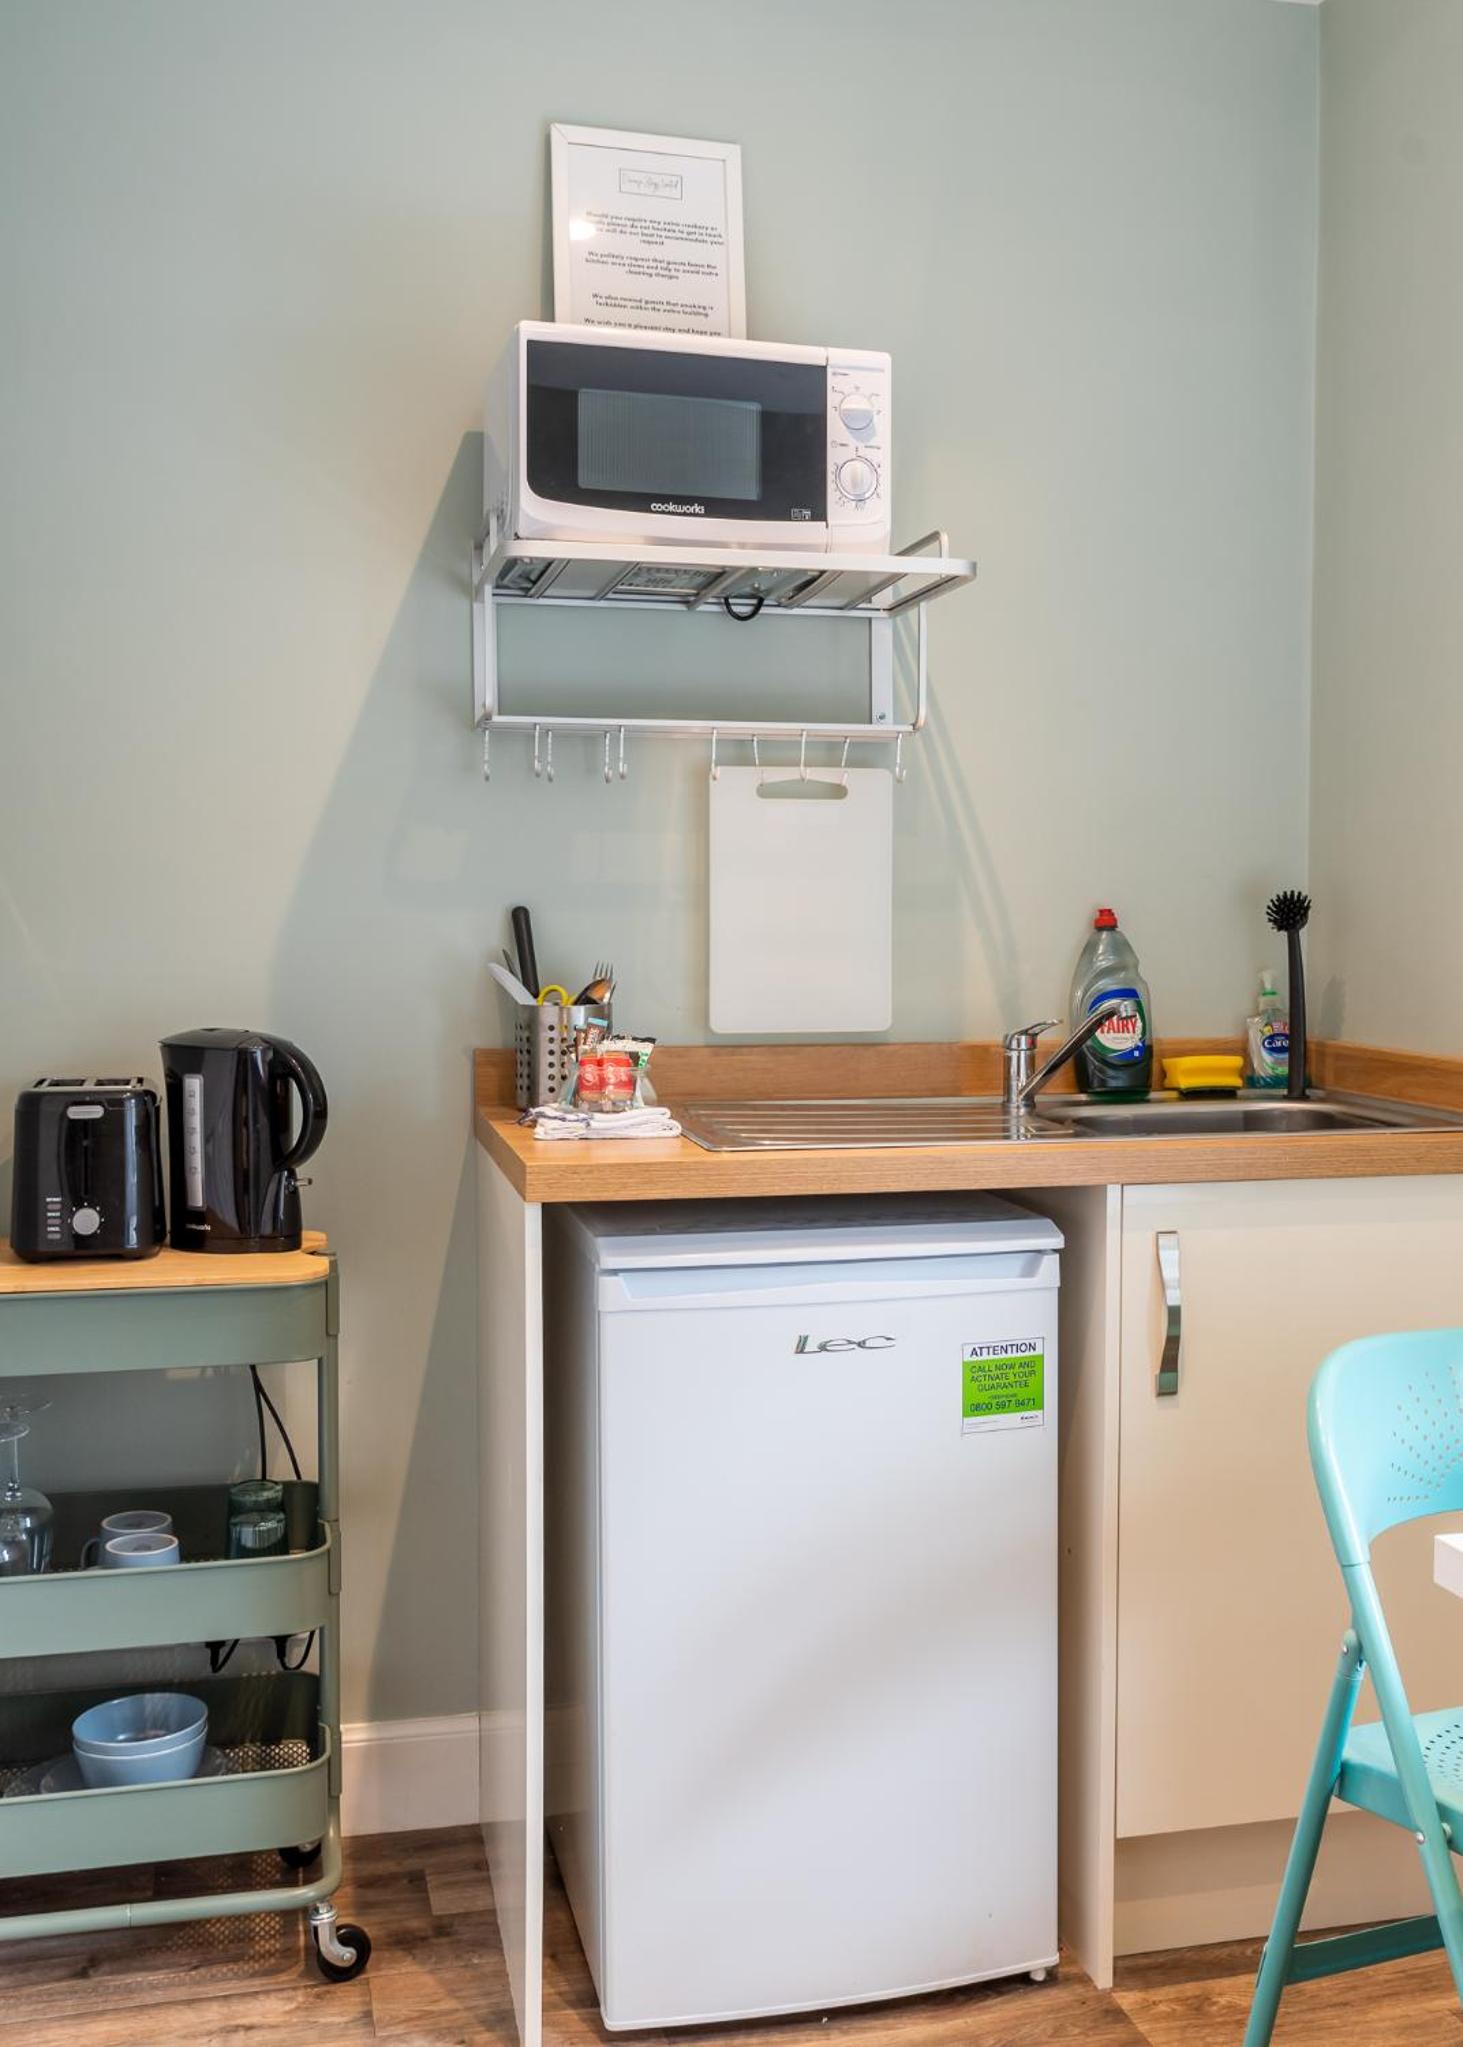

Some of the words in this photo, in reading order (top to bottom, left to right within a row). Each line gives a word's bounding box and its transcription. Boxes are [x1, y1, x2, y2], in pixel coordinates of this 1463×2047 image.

[651, 502, 705, 514] cookworks
[1264, 1039, 1289, 1048] Care
[970, 1342, 1036, 1357] ATTENTION
[970, 1364, 993, 1374] CALL
[995, 1361, 1015, 1371] NOW
[1018, 1360, 1036, 1370] AND
[970, 1372, 1009, 1383] ACTIVATE
[1013, 1369, 1037, 1380] YOUR
[978, 1379, 1030, 1392] GUARANTEE
[970, 1401, 993, 1412] 0800
